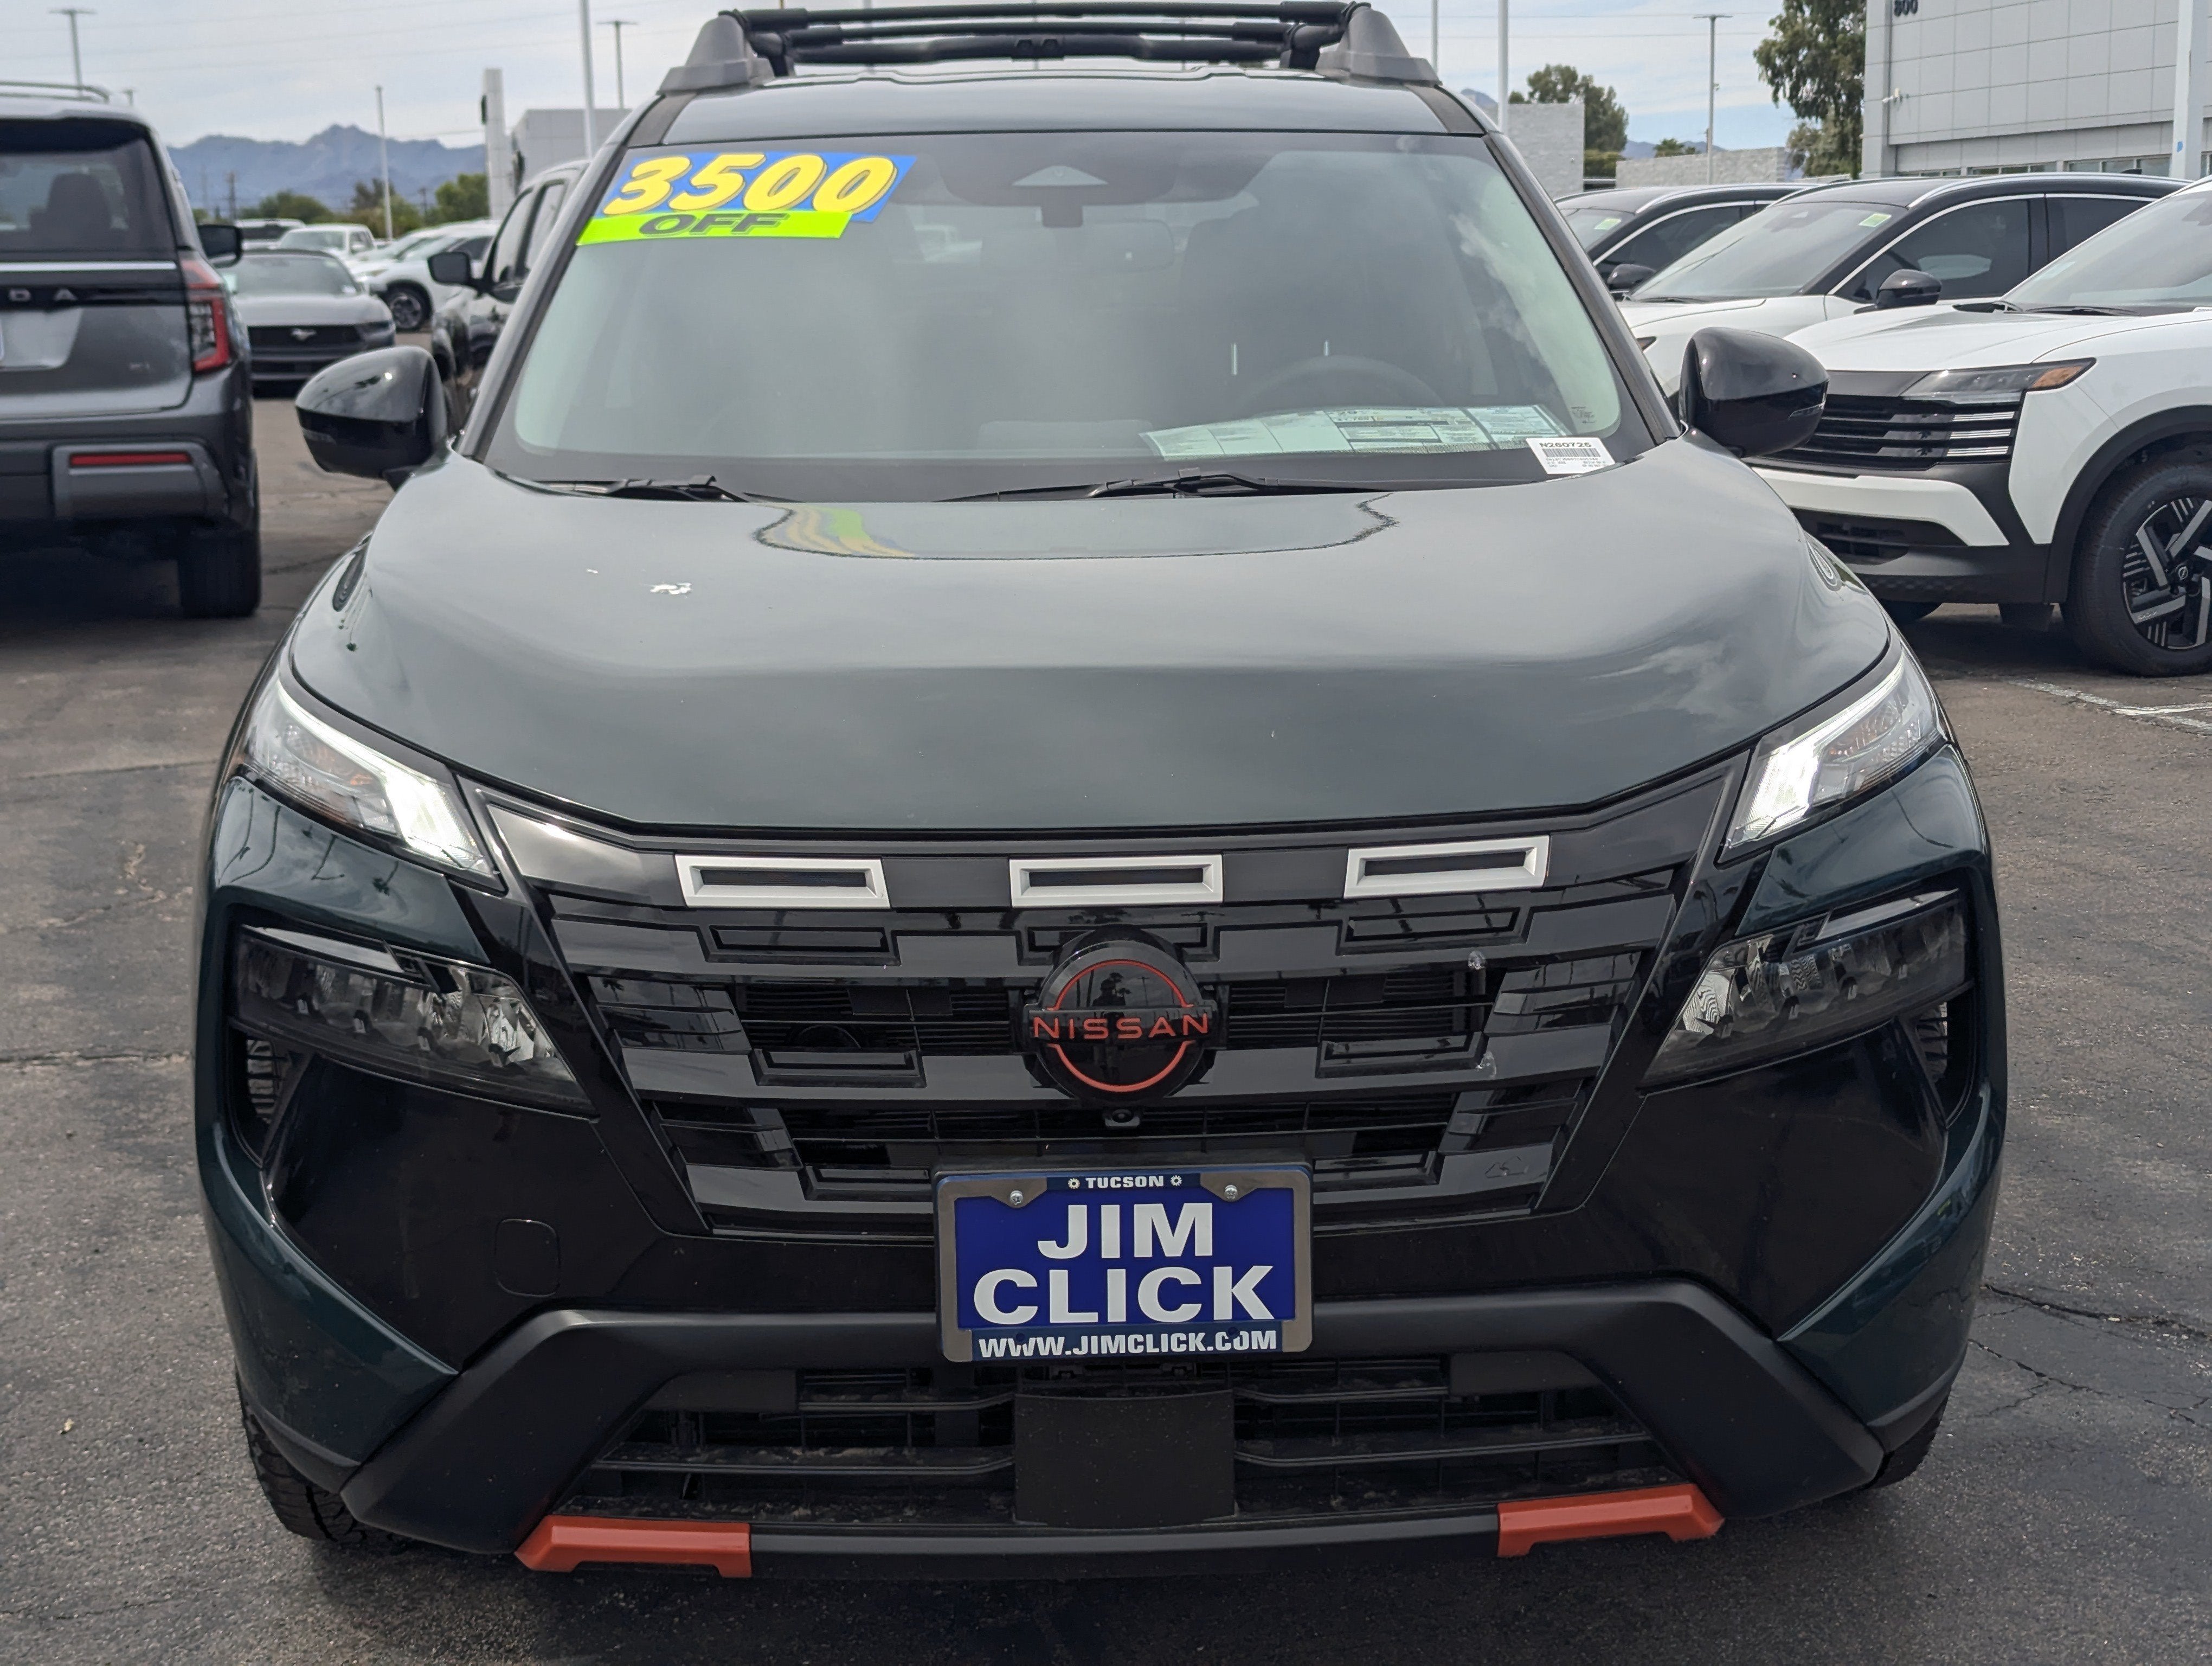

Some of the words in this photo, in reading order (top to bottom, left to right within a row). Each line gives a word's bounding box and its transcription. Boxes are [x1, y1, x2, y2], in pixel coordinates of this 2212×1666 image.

[603, 152, 898, 215] 3500
[639, 213, 790, 237] OFF
[1033, 1013, 1209, 1040] NISSAN
[1085, 1176, 1164, 1189] TUCSON
[1038, 1203, 1213, 1259] JIM
[974, 1265, 1275, 1325] CLICK
[978, 1330, 1277, 1357] WWW.JIMCLICK.COM
